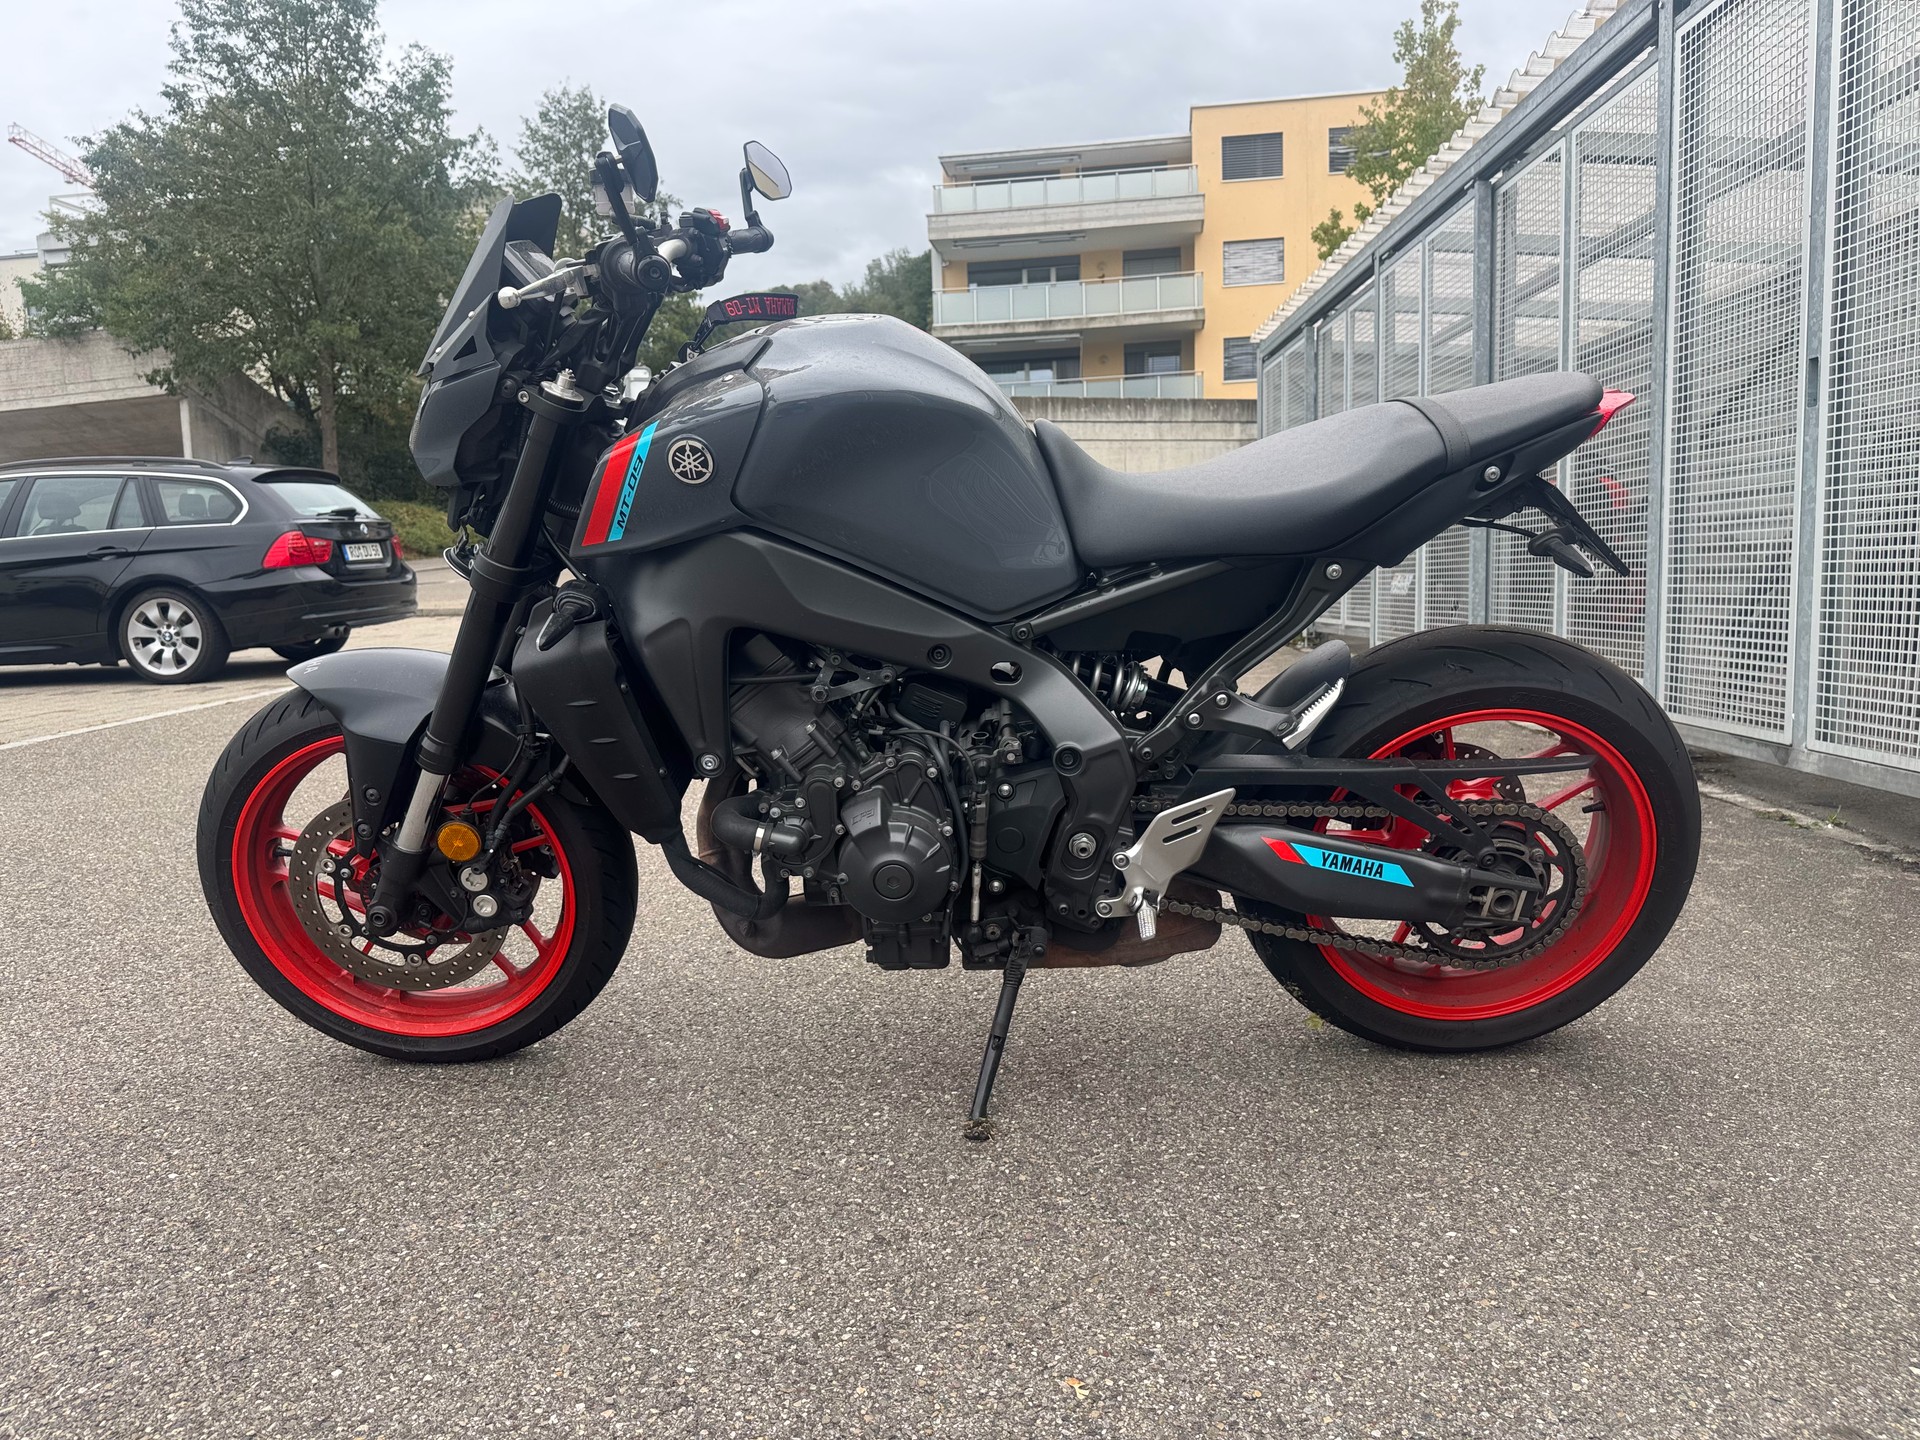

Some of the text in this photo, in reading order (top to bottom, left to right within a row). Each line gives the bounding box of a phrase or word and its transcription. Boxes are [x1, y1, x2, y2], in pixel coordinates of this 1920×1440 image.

[725, 297, 795, 316] YAMAHA MT-09
[616, 454, 643, 529] MT-09
[1321, 851, 1384, 878] YAMAHA
